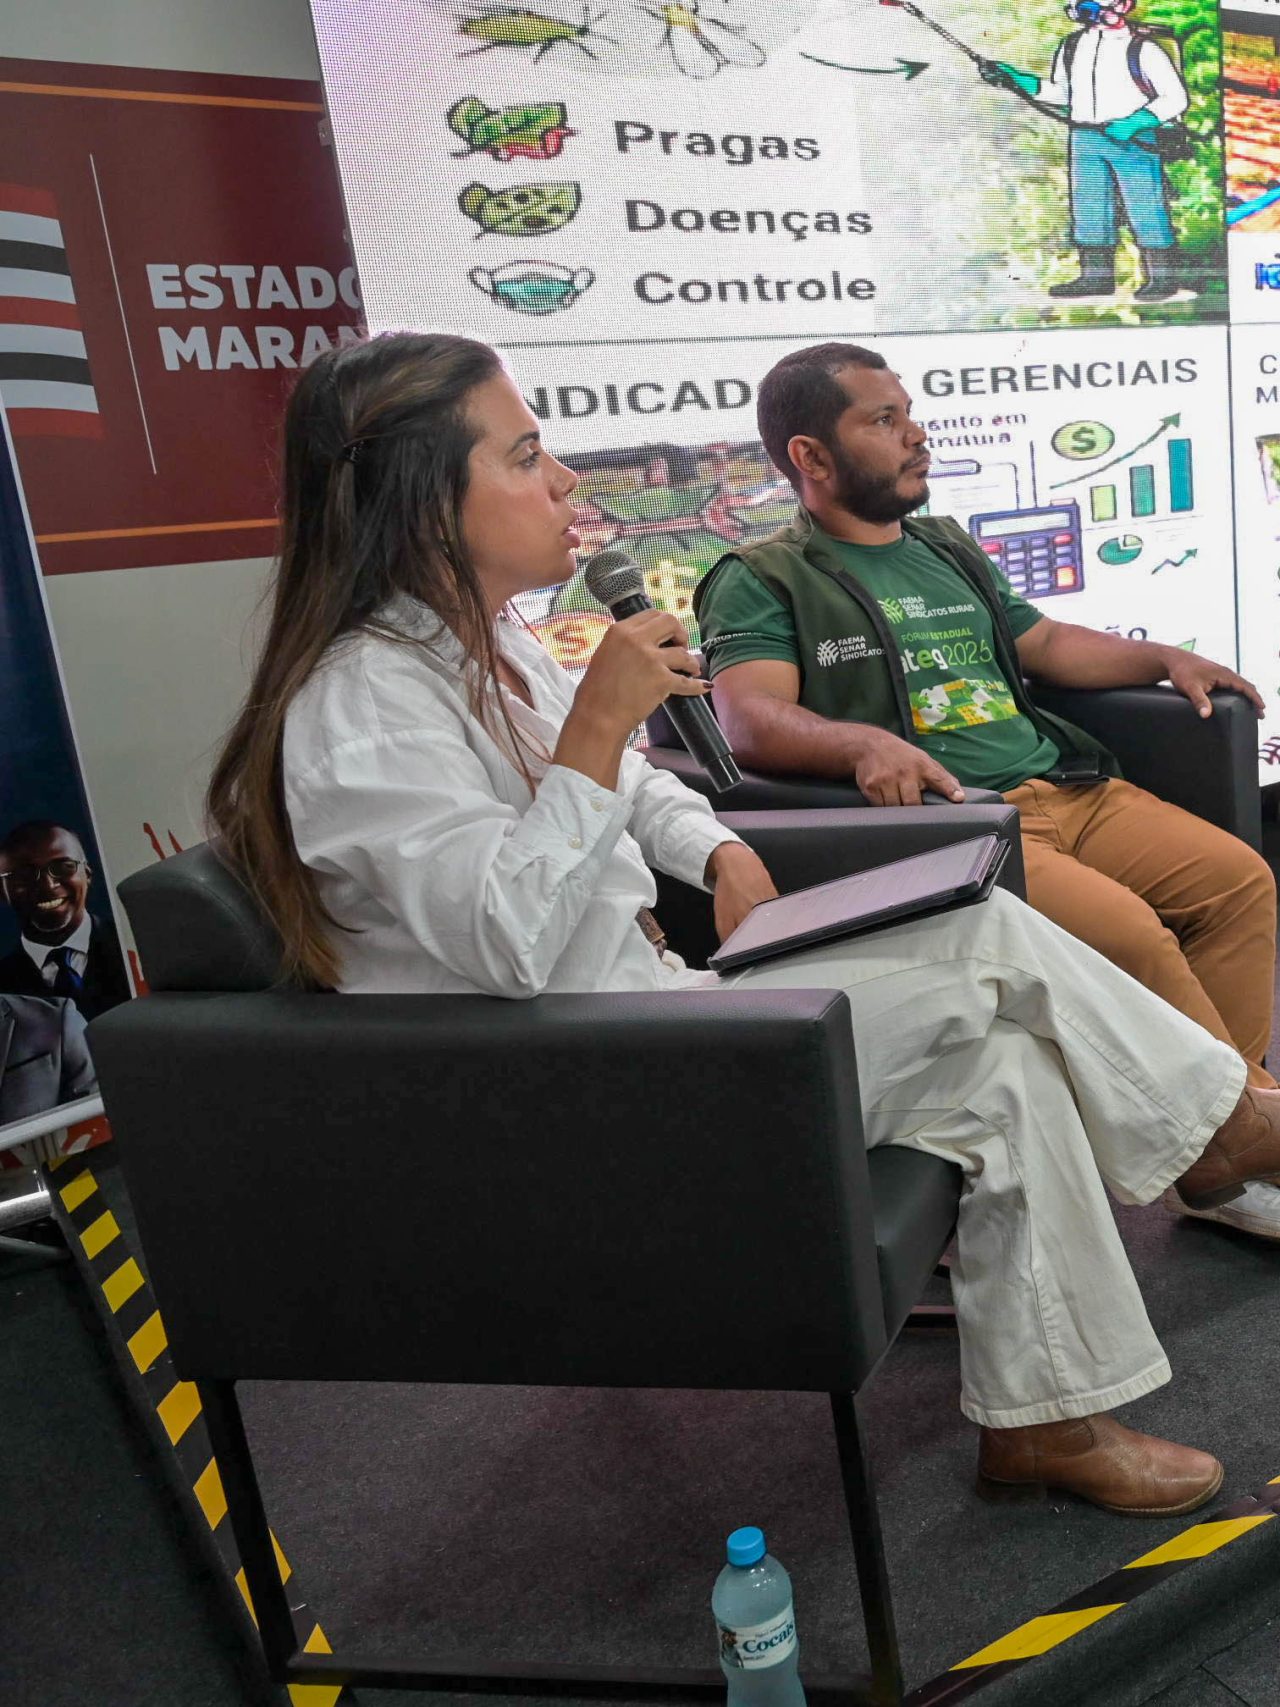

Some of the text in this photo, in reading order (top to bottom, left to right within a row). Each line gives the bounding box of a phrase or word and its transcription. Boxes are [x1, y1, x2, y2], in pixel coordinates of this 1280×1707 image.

[614, 120, 820, 166] Pragas
[625, 199, 873, 241] Doenças
[634, 271, 876, 305] Controle
[922, 358, 1198, 398] GERENCIAIS
[948, 604, 976, 614] RURAIS
[838, 635, 866, 647] FAEMA
[929, 626, 974, 640] ESTADUAL
[839, 643, 867, 654] SENAR
